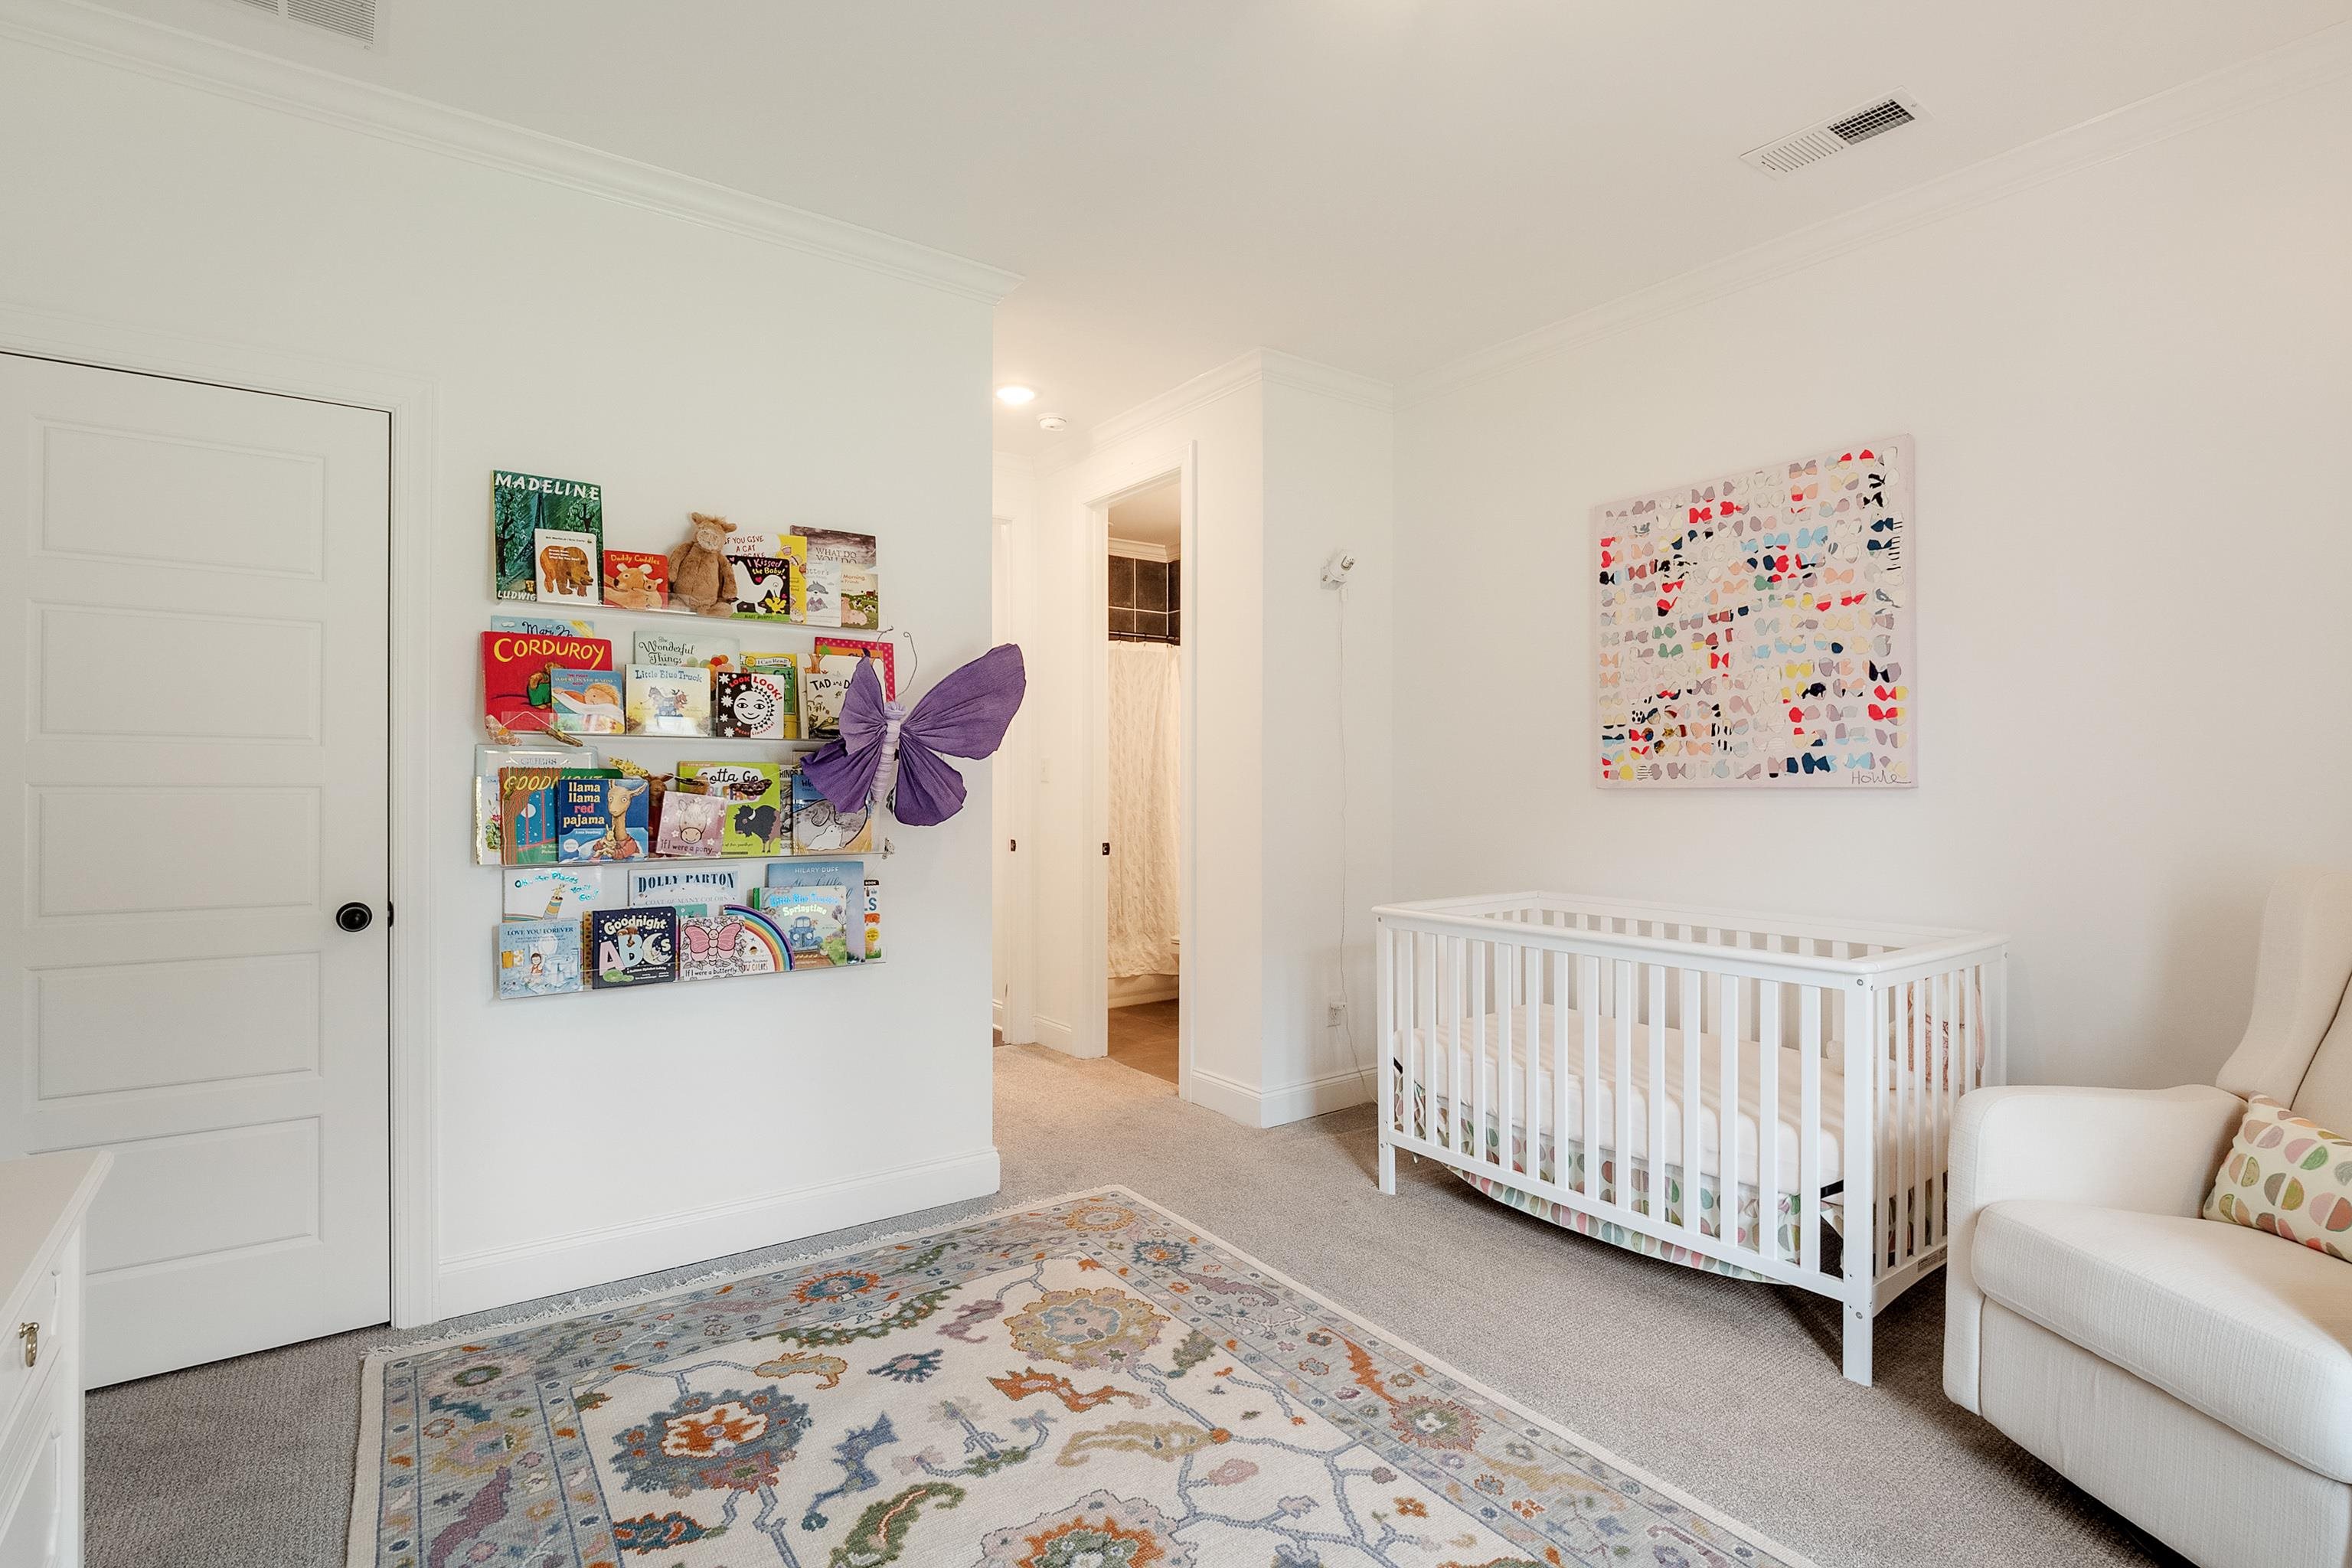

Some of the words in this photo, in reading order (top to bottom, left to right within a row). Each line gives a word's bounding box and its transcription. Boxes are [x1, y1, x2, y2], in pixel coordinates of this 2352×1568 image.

[495, 473, 599, 500] MADELINE
[732, 536, 746, 544] YOU
[746, 535, 764, 544] GIVE
[610, 554, 632, 564] Daddy
[634, 554, 660, 565] Cuddles
[815, 547, 840, 557] WHAT
[844, 550, 857, 559] DO
[746, 559, 752, 567] I
[753, 558, 782, 568] Kissed
[764, 567, 786, 576] Baby!
[497, 590, 537, 602] LUDWIG
[521, 621, 554, 636] Mary
[494, 638, 605, 670] CORDUROY
[639, 640, 695, 656] Wonderful
[648, 652, 683, 665] Things
[635, 670, 658, 679] Little
[659, 669, 678, 679] Blue
[678, 671, 702, 683] Truck
[729, 676, 750, 688] LOOK
[753, 675, 783, 701] LOOK!
[810, 679, 831, 691] TAD
[742, 770, 759, 783] Go
[503, 775, 603, 792] GOODN
[569, 782, 601, 792] llama
[568, 792, 600, 803] llama
[574, 803, 595, 814] red
[563, 814, 605, 828] pajama
[660, 839, 667, 849] If
[639, 875, 678, 893] DOLLY
[685, 872, 734, 889] PARTON
[782, 903, 828, 916] Springtime
[604, 915, 668, 936] Goodnight
[599, 933, 673, 977] ABCs
